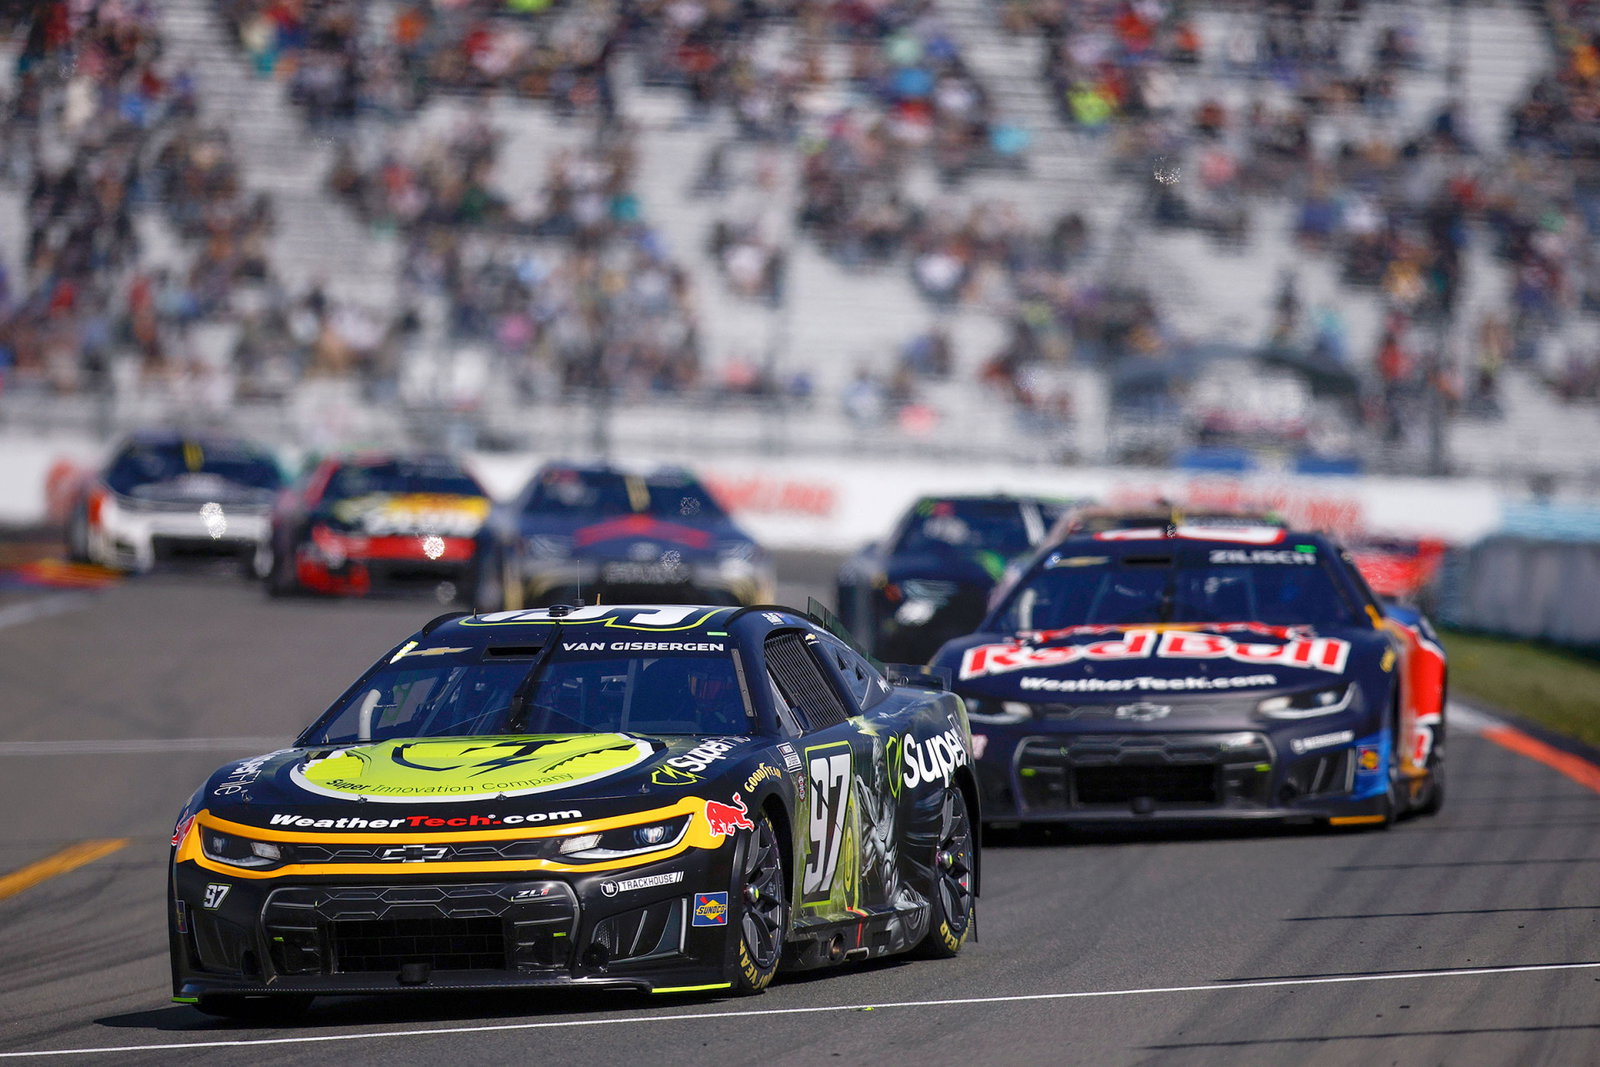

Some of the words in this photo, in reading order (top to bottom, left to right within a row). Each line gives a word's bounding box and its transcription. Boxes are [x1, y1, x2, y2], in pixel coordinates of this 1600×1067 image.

[562, 642, 605, 651] VAN
[610, 642, 724, 652] GISBERGEN
[959, 629, 1157, 681] Red
[1157, 630, 1351, 675] Bull
[1019, 674, 1277, 693] WeatherTech.com
[326, 778, 372, 791] Super
[370, 784, 474, 793] Innovation
[481, 773, 574, 790] Company
[803, 753, 851, 895] 97
[622, 873, 674, 890] TRACKHOUSE
[203, 884, 230, 908] 97
[697, 904, 726, 915] SUNOCO
